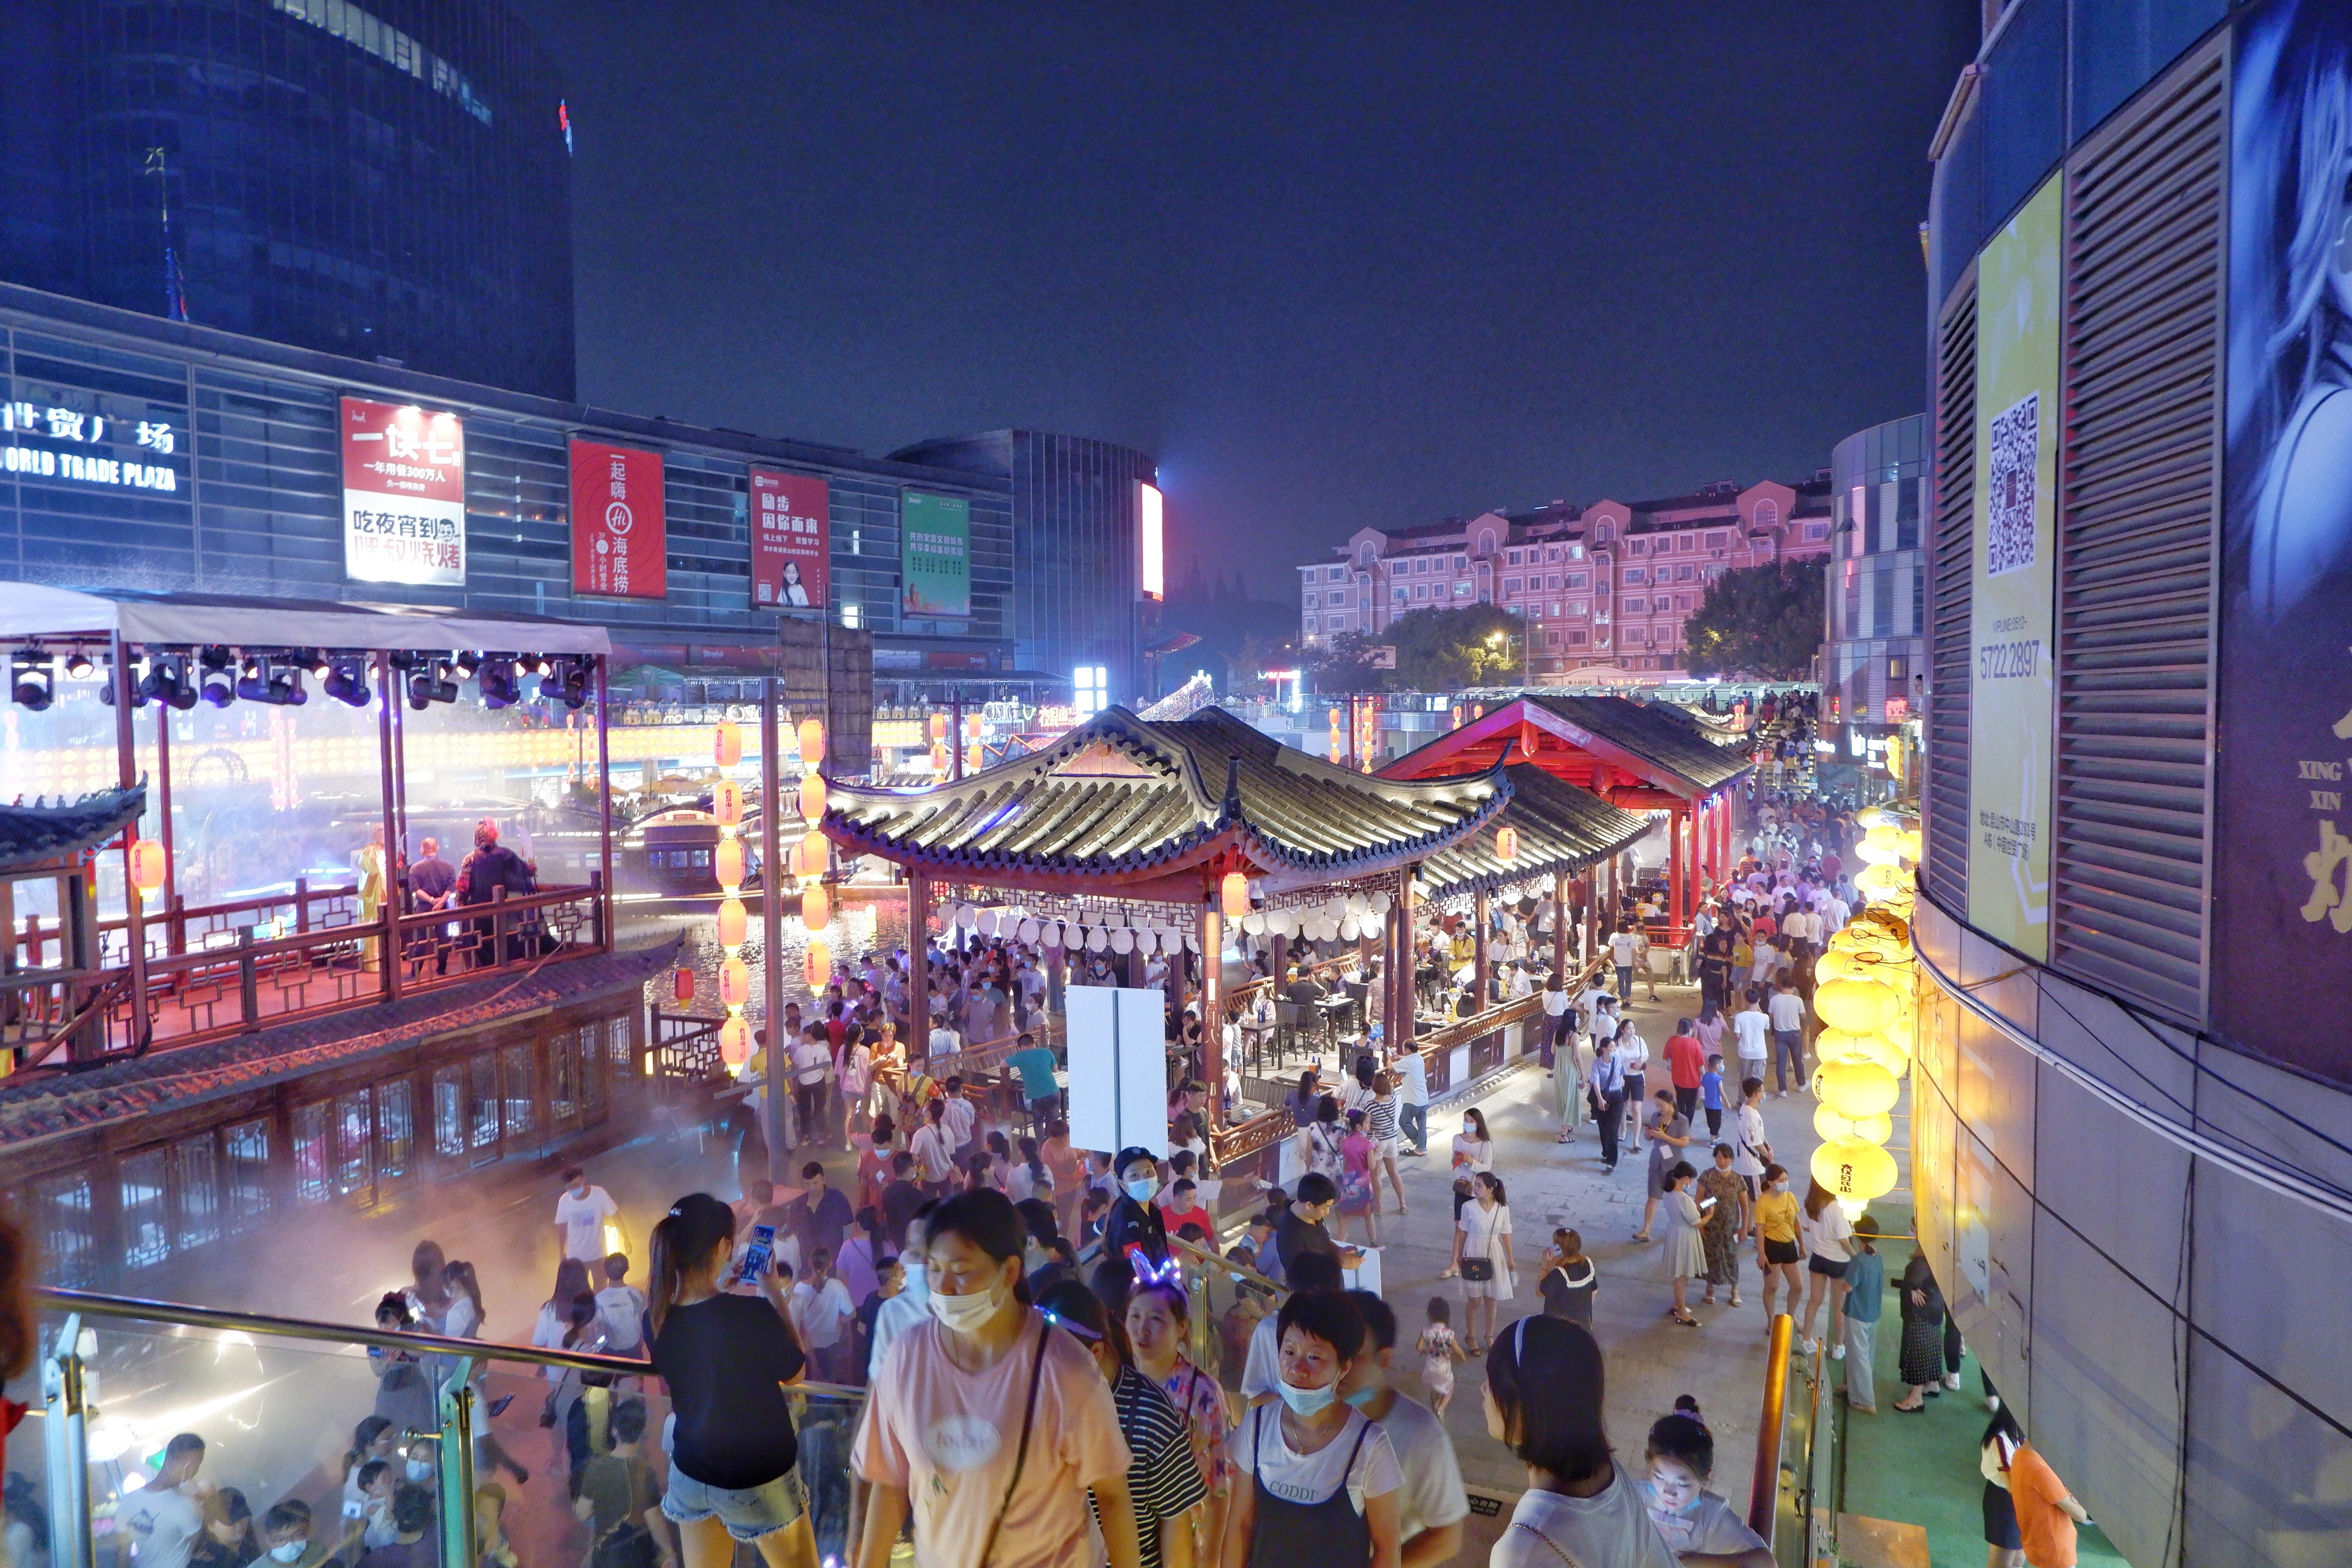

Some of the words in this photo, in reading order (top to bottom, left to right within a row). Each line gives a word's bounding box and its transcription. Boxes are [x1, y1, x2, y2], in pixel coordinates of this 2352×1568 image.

[0, 446, 55, 476] ORLD
[59, 453, 119, 485] TRADE
[122, 462, 176, 492] PLAZA
[363, 460, 446, 483] 一年用餐300万人
[610, 454, 626, 500] 一起嗨
[762, 492, 789, 512] 励步
[353, 510, 438, 540] 吃夜宵到
[612, 508, 627, 526] Hi
[762, 512, 818, 534] 因你而来
[763, 533, 788, 543] 线上线下
[795, 536, 820, 546] 完整学习
[613, 536, 628, 593] 海底捞
[1980, 643, 2007, 680] 5722
[2009, 639, 2040, 677] 2897
[1038, 706, 1068, 728] 夜昆山
[2298, 760, 2343, 781] XING
[2310, 790, 2342, 812] XIN
[1839, 1163, 1853, 1193] 夜昆山
[1269, 1480, 1314, 1501] CODDI
